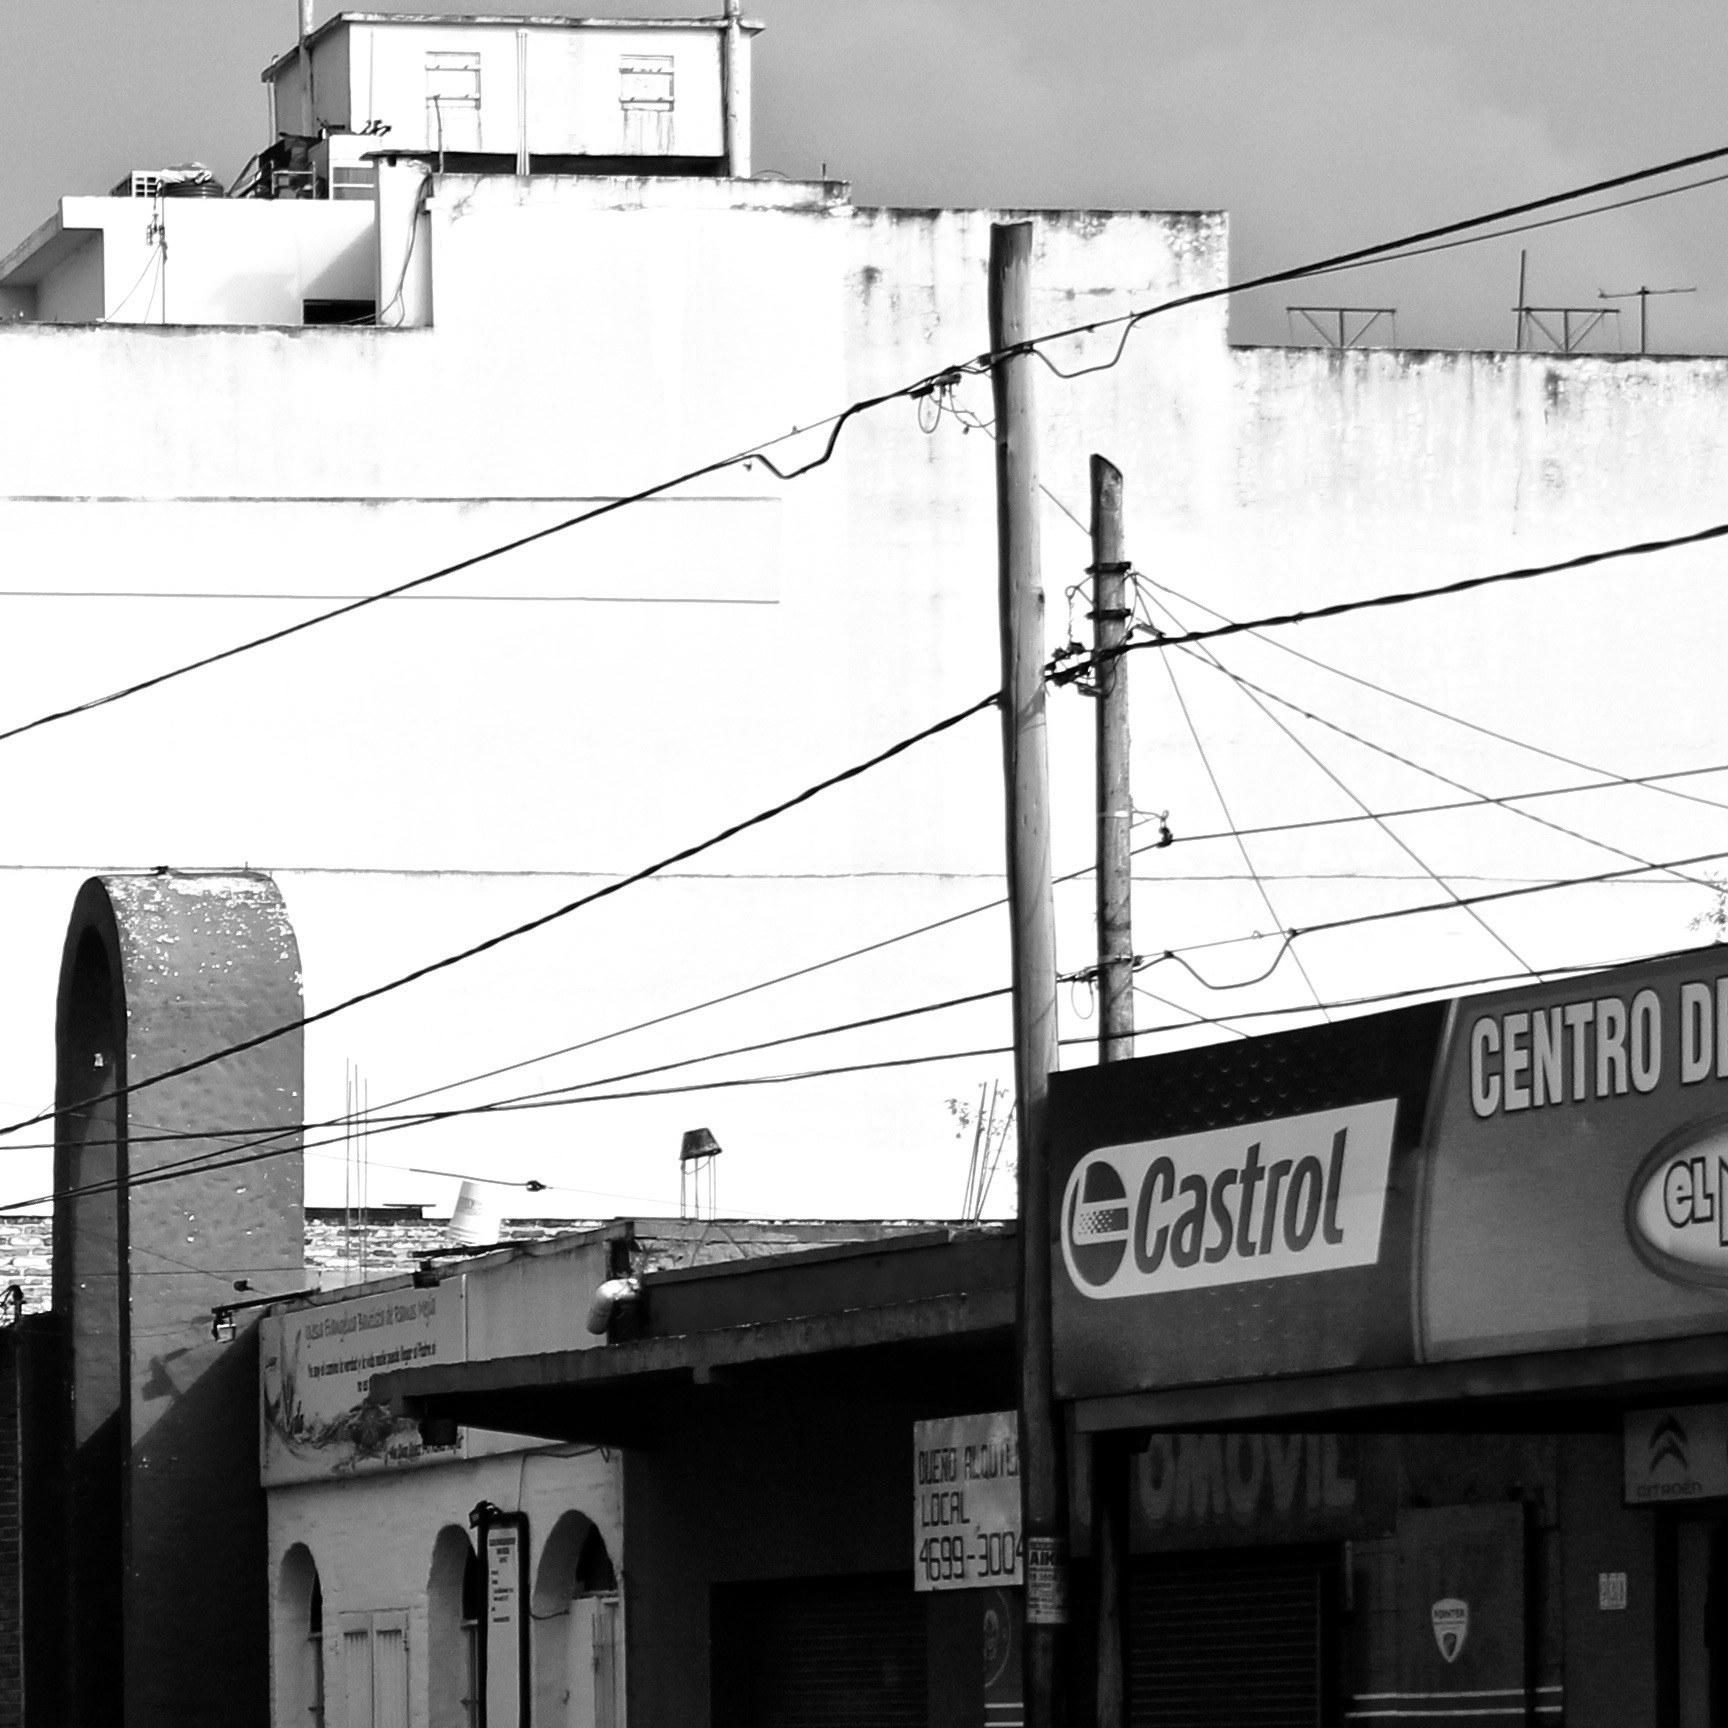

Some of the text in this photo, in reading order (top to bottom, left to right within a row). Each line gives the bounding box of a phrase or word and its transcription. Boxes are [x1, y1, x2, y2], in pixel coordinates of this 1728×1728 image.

[1470, 988, 1662, 1119] CENTRO
[1132, 1126, 1349, 1275] Castrol
[921, 1491, 971, 1527] LOCAL
